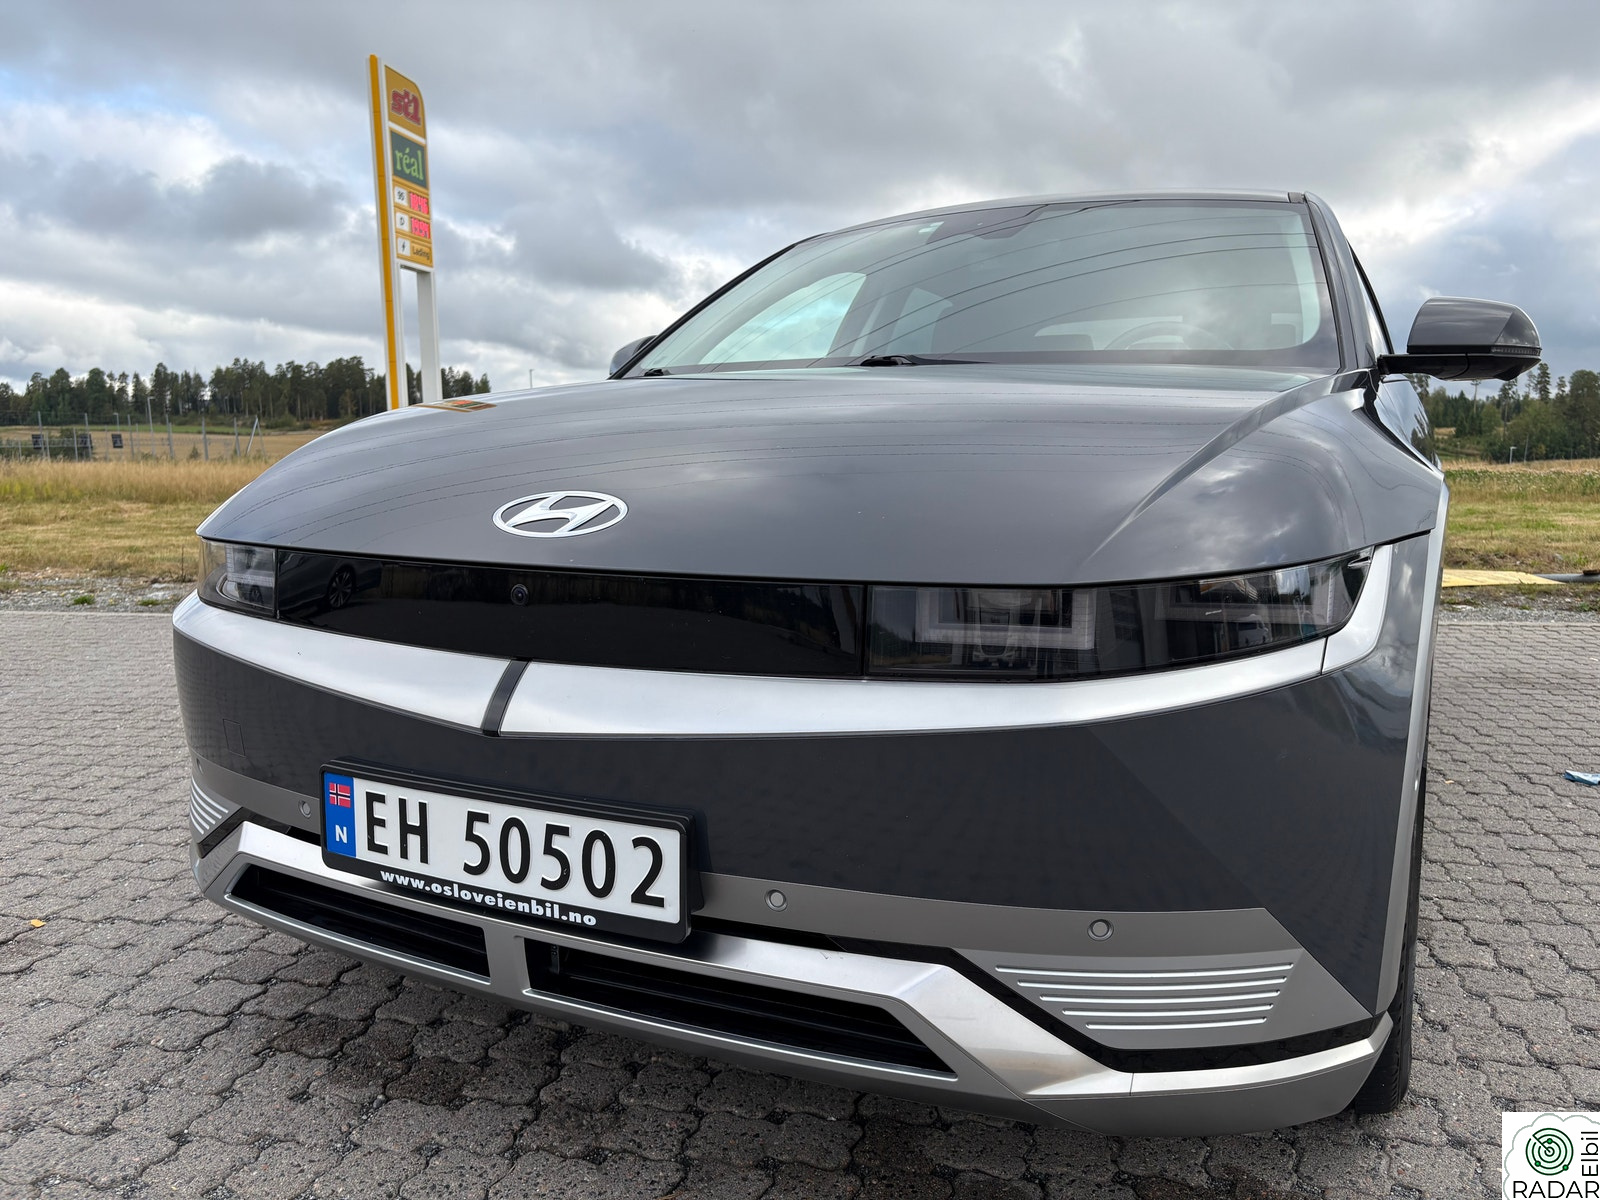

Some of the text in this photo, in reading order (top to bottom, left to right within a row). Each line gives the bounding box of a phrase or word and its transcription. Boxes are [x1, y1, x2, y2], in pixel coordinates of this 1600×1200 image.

[391, 88, 421, 126] st1
[395, 147, 424, 180] réal
[335, 824, 348, 844] N
[365, 790, 665, 908] EH 50502
[380, 869, 597, 926] www.osloveienbil.no
